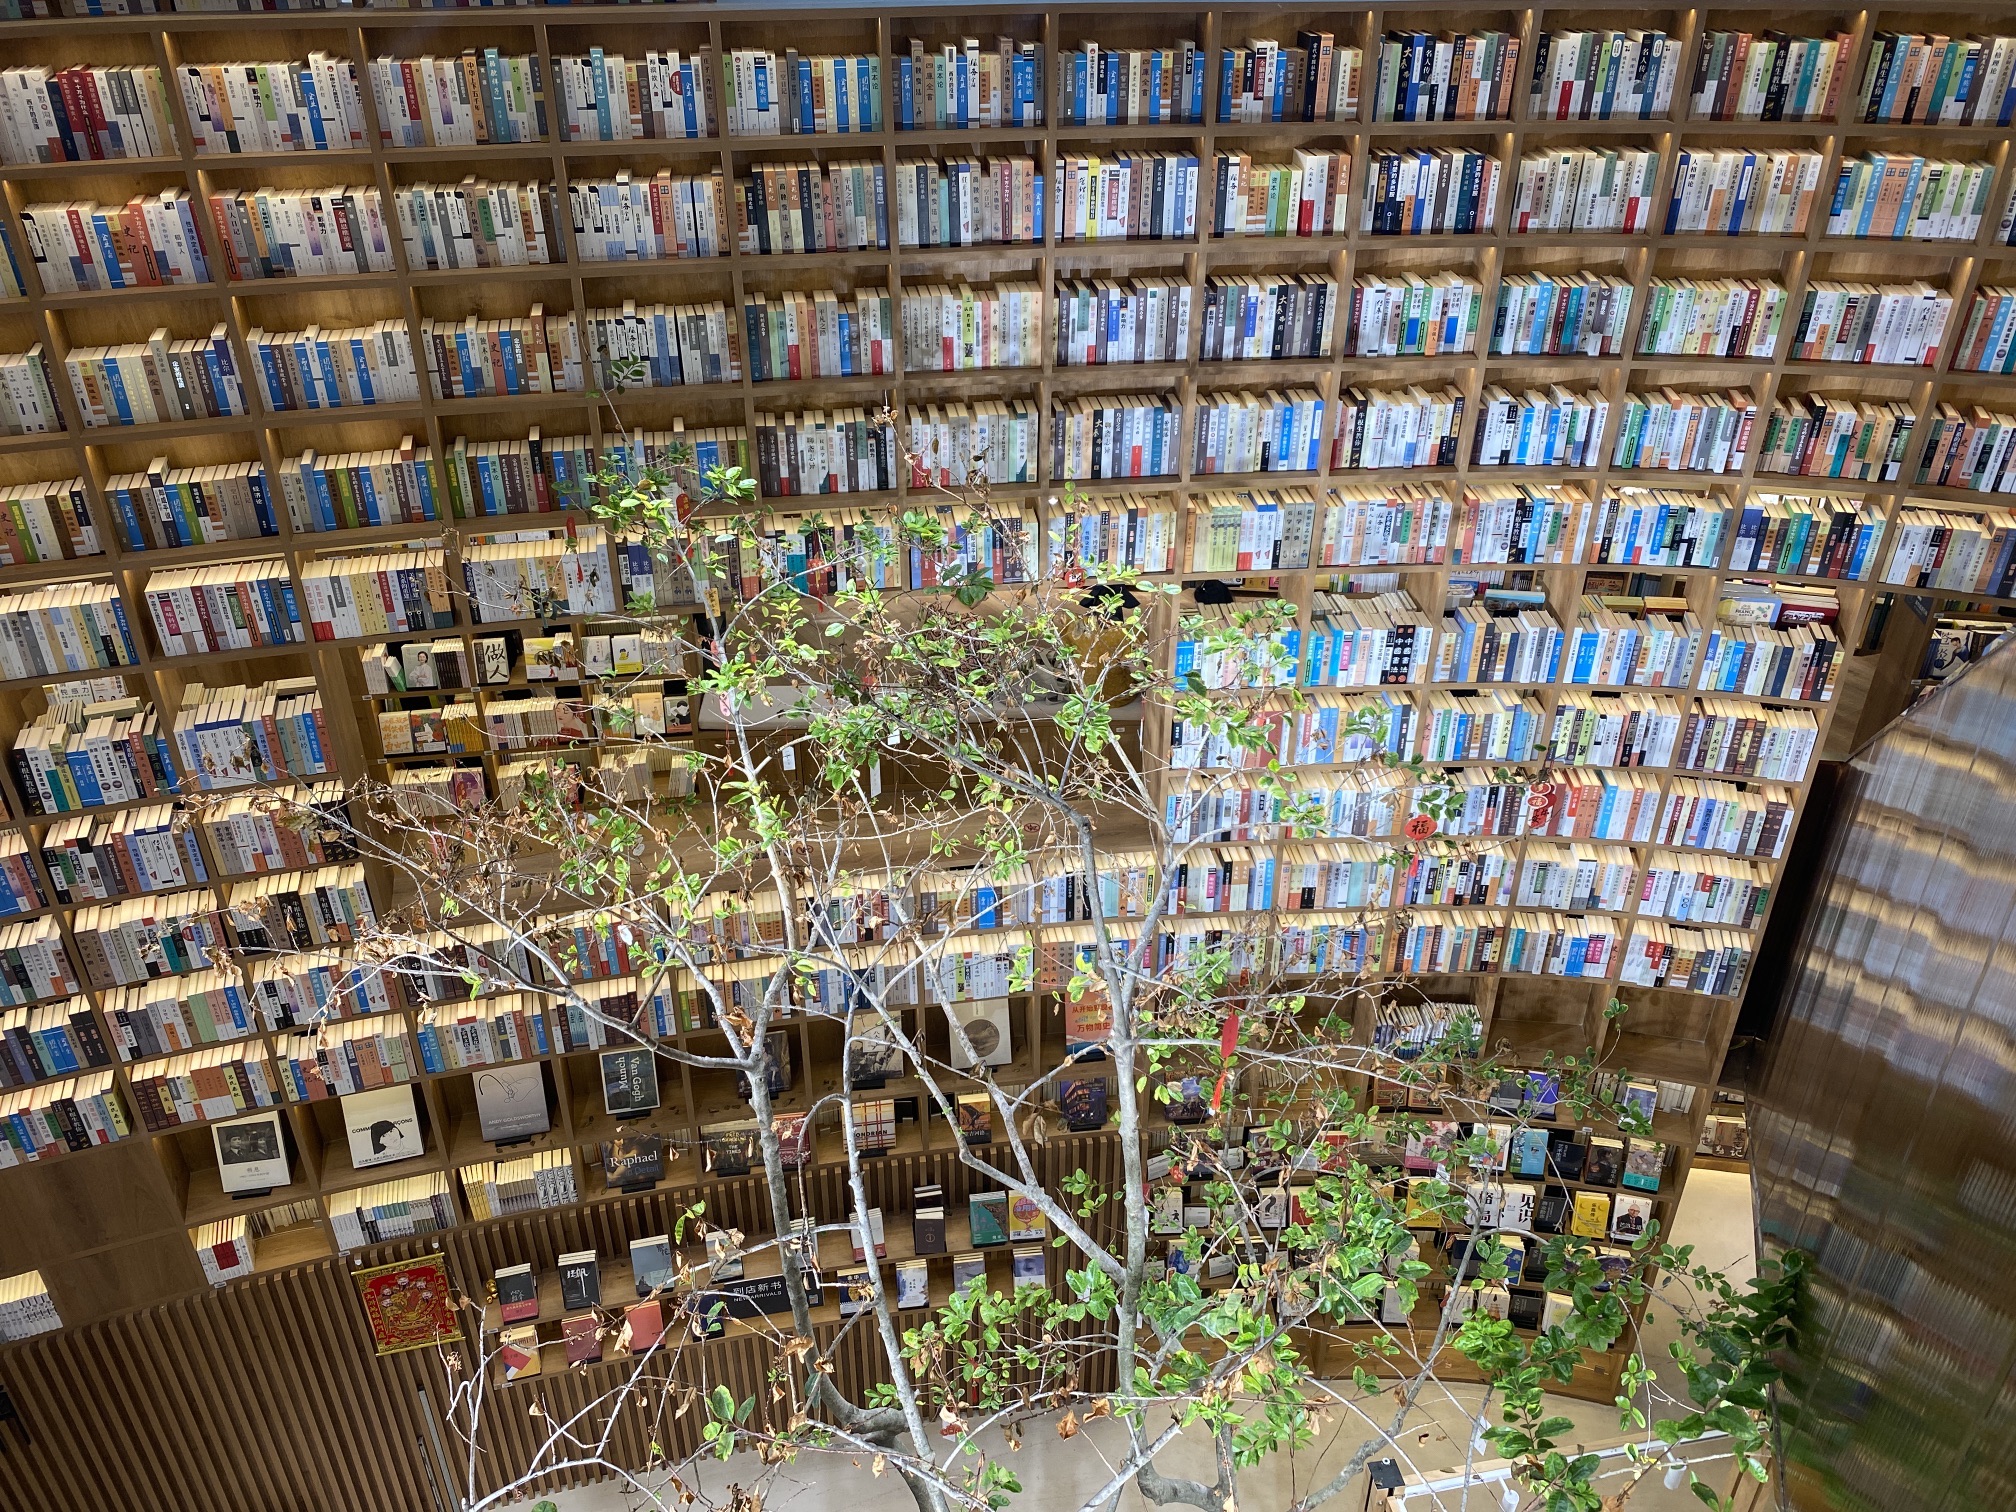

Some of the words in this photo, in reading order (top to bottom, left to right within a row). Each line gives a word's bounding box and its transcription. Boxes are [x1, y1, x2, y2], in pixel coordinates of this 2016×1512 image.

[1398, 47, 1412, 88] 大秦帝国
[1424, 50, 1432, 74] 名人传
[1536, 46, 1547, 74] 名人传
[1639, 46, 1649, 73] 名人传
[1770, 49, 1787, 93] 牛根生教你
[1989, 43, 2003, 75] 人格理论
[871, 65, 879, 90] 资本论
[936, 64, 944, 88] 资本论
[1874, 52, 1892, 95] 牛根生教你
[252, 88, 262, 108] 影响力
[1687, 158, 1698, 188] 人格理论
[1773, 160, 1785, 190] 人格理论
[1948, 172, 1959, 196] 资本论
[227, 203, 240, 235] 狂人日记
[317, 217, 327, 235] 影响力
[122, 226, 140, 254] 史记
[1277, 295, 1287, 331] 大秦帝国
[490, 342, 502, 368] 史记
[1094, 419, 1102, 453] 大秦帝国
[1355, 412, 1365, 447] 牛根生教你
[485, 642, 508, 680] 做人
[20, 760, 36, 794] 牛根生教你
[1077, 1022, 1111, 1033] 万物简史
[616, 1056, 630, 1090] Munch
[631, 1056, 639, 1076] Van
[632, 1078, 642, 1102] Gogh
[503, 1112, 542, 1122] GOLDSWORTHY
[854, 1129, 888, 1137] ONDRIAN
[610, 1152, 658, 1168] Raphael
[636, 1164, 659, 1175] Detail
[1518, 1193, 1536, 1223] 见识
[733, 1281, 782, 1294] 到店新书
